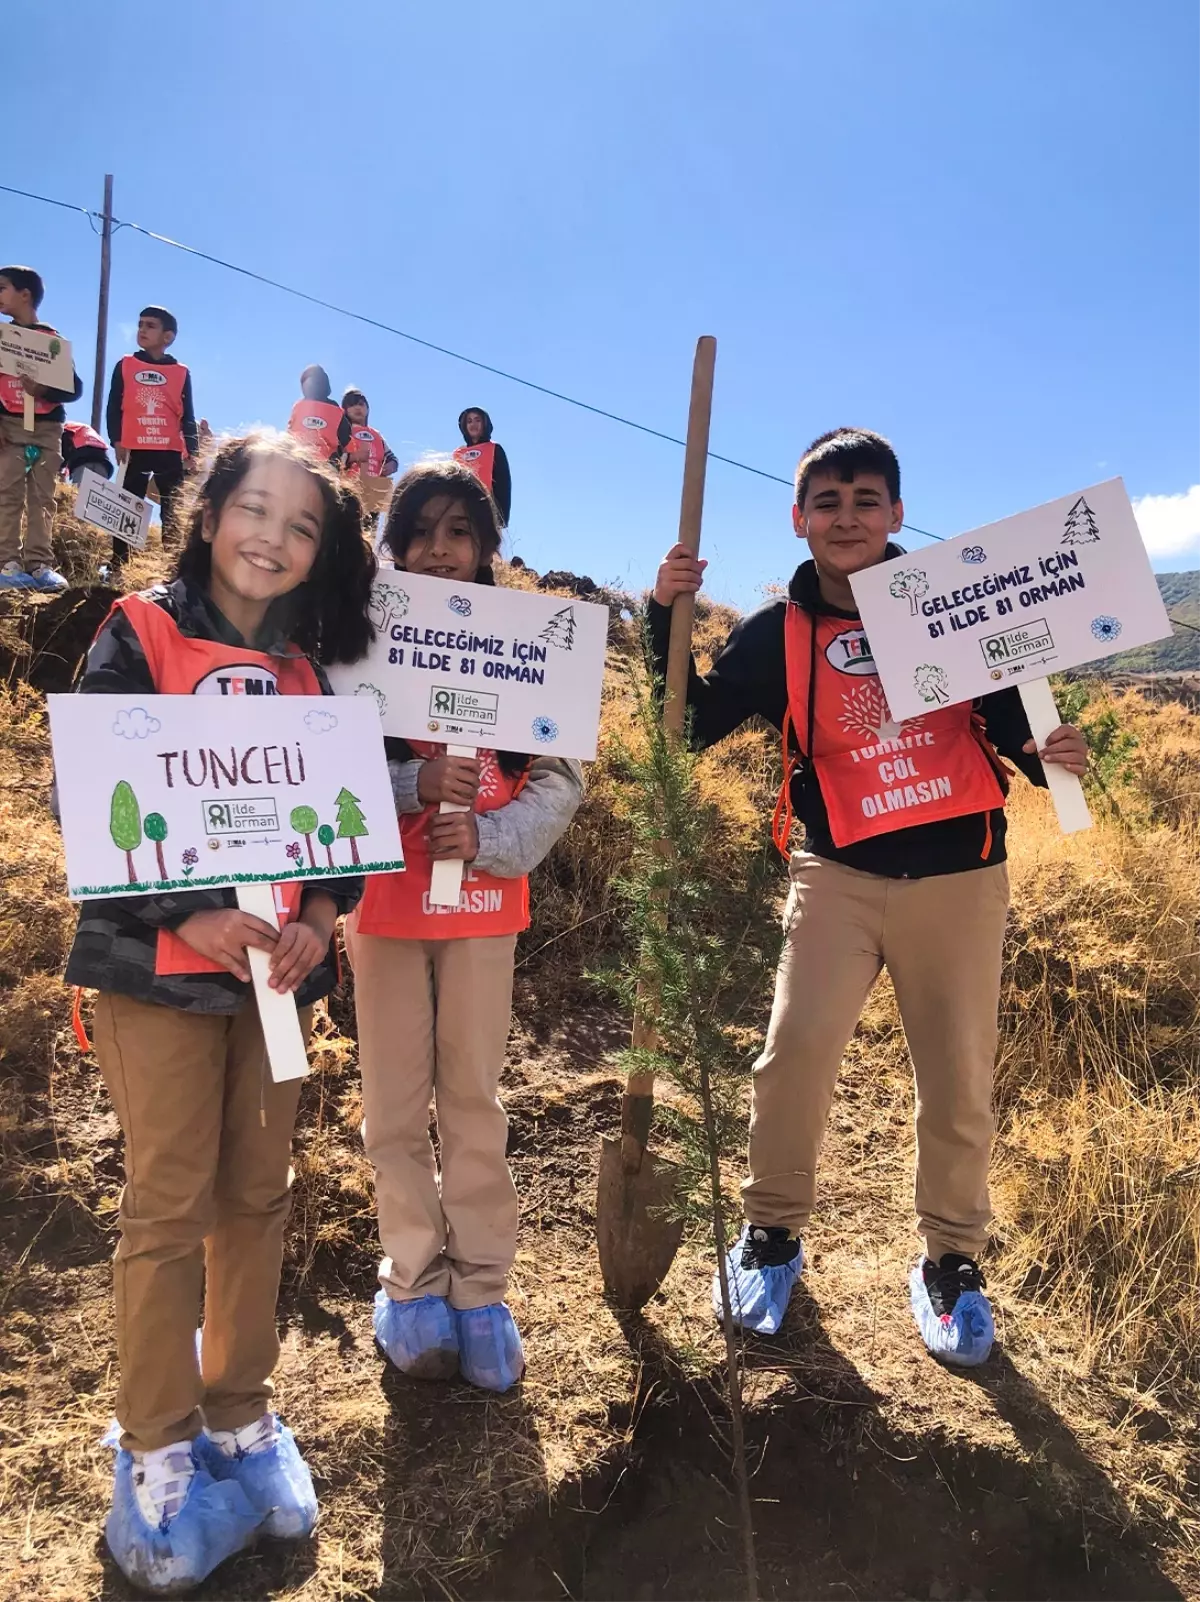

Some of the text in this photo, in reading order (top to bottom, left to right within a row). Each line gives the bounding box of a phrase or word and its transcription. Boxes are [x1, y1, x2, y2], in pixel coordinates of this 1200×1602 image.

[91, 495, 122, 517] orman
[101, 513, 119, 530] ilde
[921, 549, 1079, 617] GELECEĞİMİZ İÇİN
[927, 572, 1085, 639] 81 İLDE 81 ORMAN
[390, 624, 547, 665] GELECEĞİMİZ İÇİN
[1006, 631, 1029, 645] ilde
[1011, 638, 1049, 656] orman
[388, 647, 545, 685] 81 İLDE 81 ORMAN
[457, 693, 479, 706] ilde
[456, 708, 493, 720] orman
[156, 741, 306, 790] TUNCELİ
[878, 753, 920, 787] ÇÖL
[861, 776, 952, 818] OLMASIN
[232, 804, 256, 815] ilde
[234, 818, 275, 828] orman
